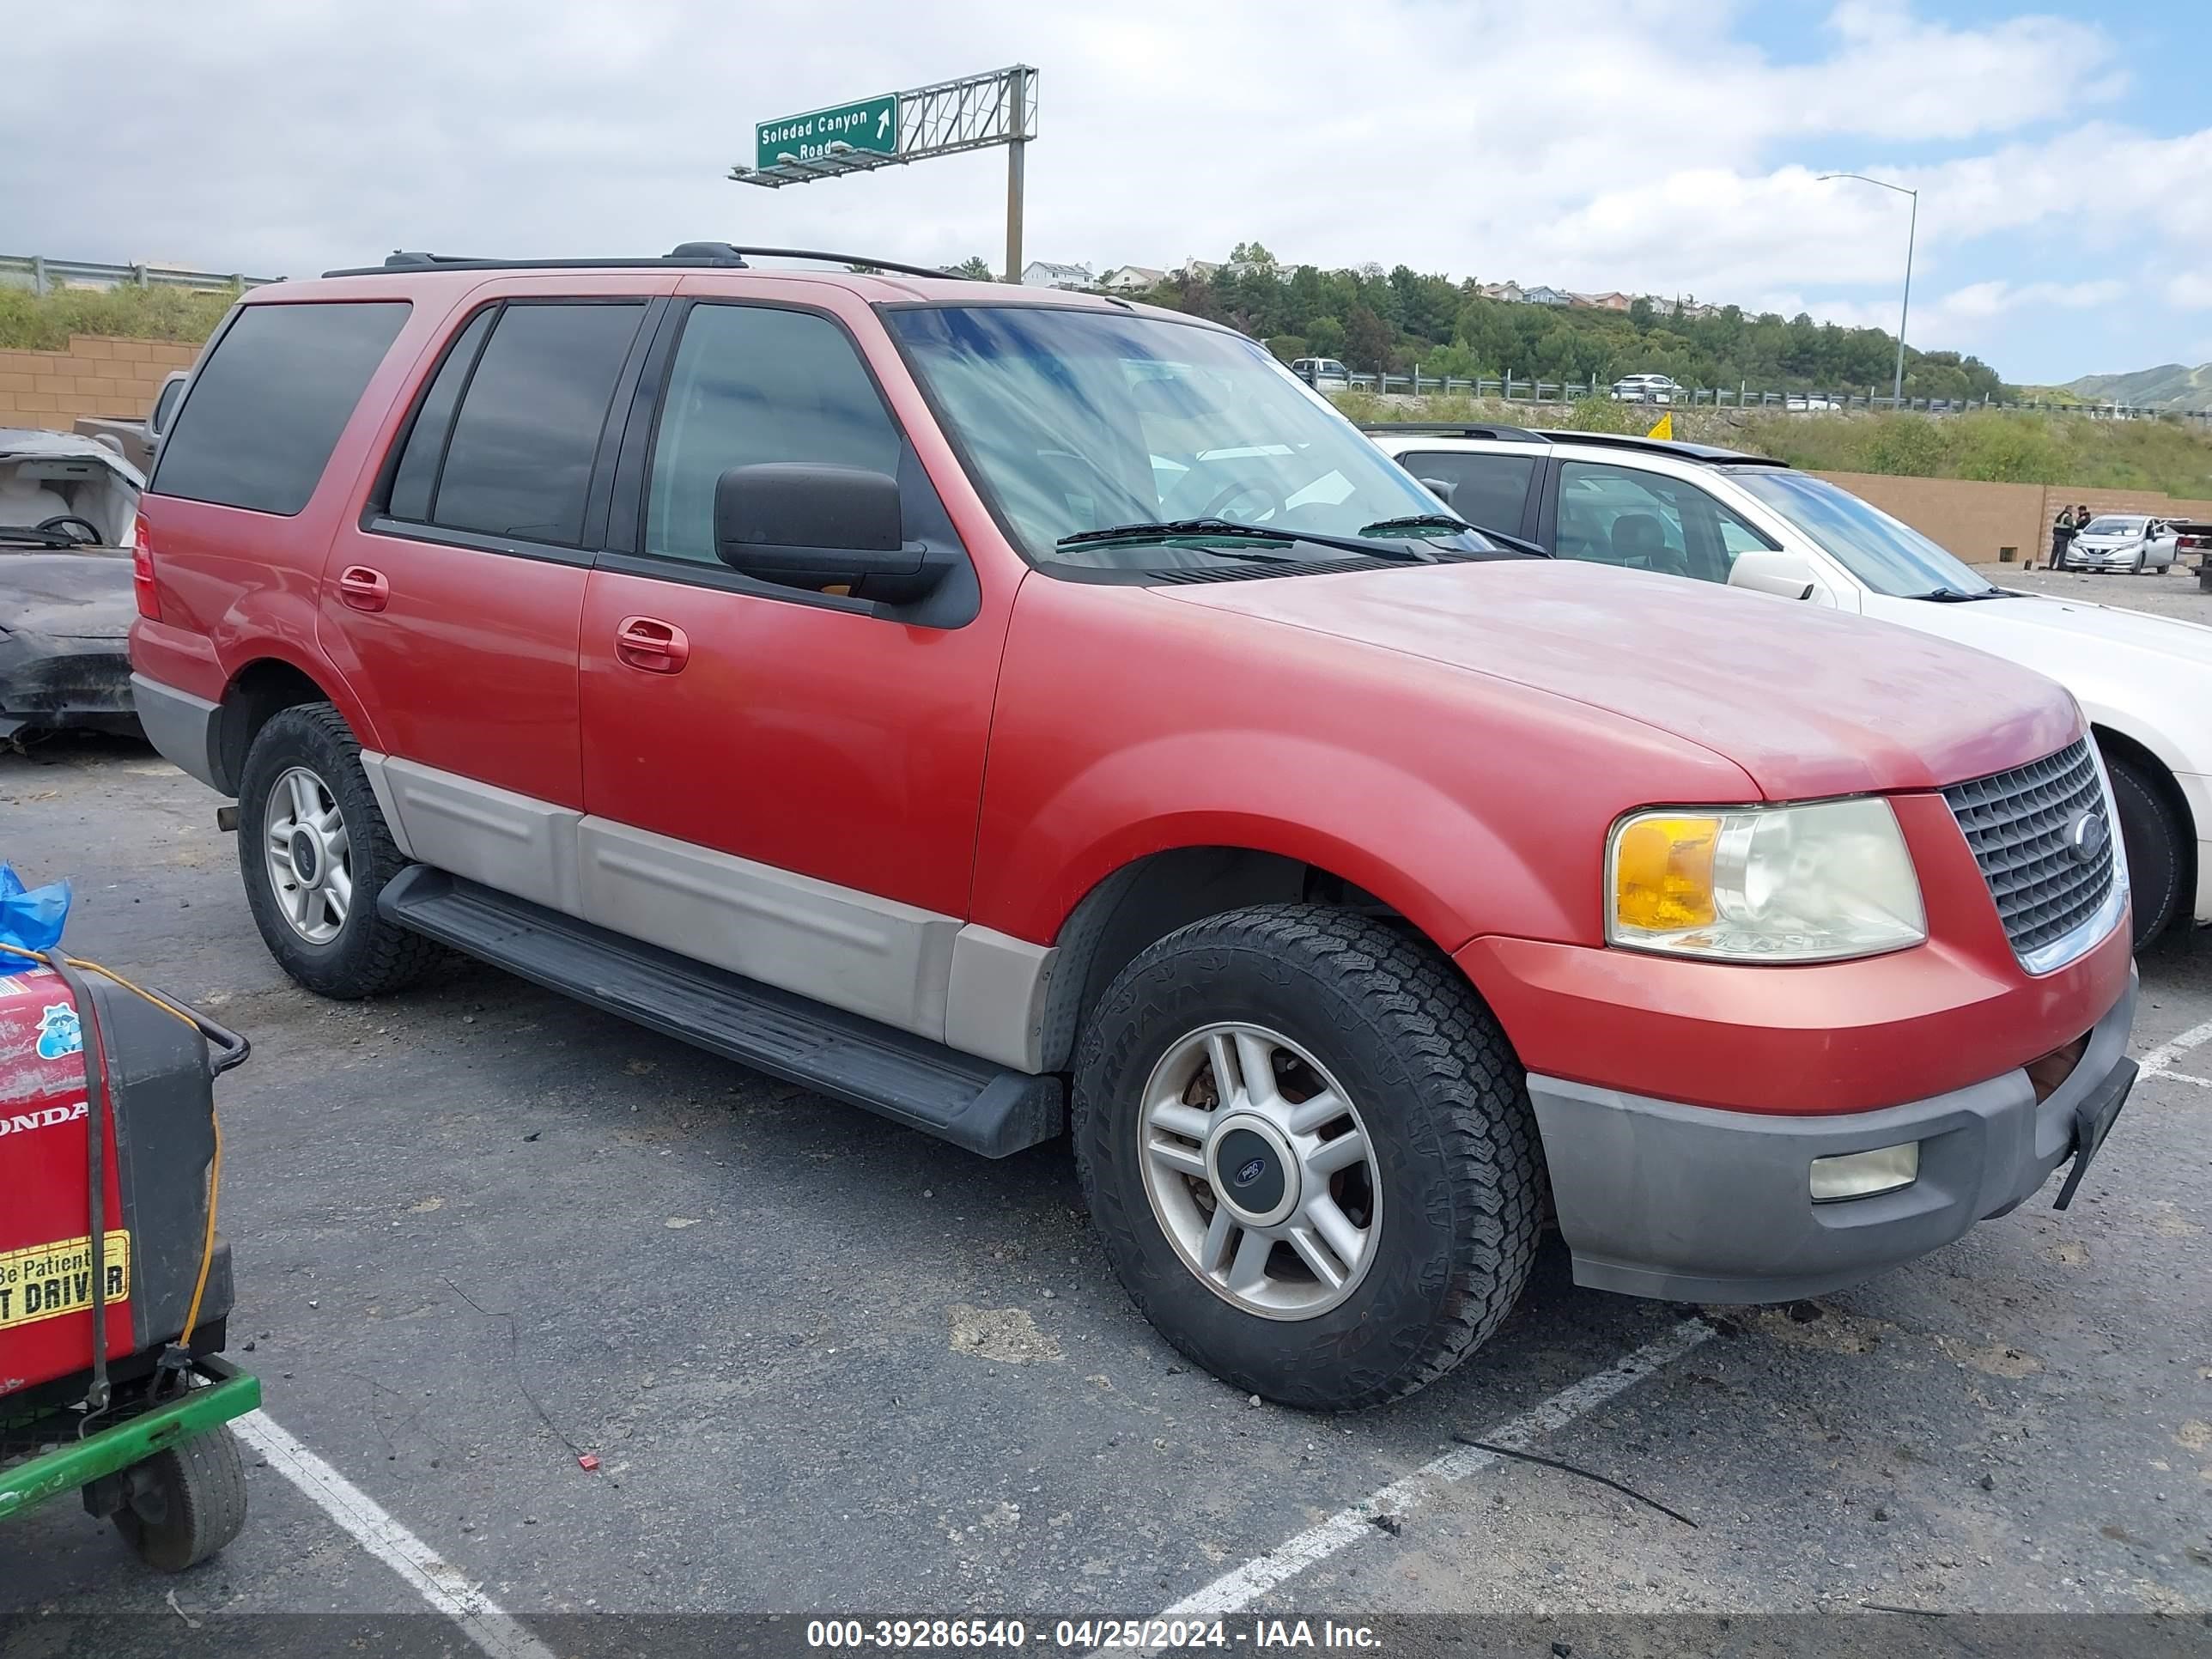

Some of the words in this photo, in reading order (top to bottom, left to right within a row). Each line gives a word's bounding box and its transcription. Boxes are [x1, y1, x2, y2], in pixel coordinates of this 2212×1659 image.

[763, 120, 812, 144] Soledad
[818, 111, 867, 133] Canyon
[799, 139, 831, 160] Road
[24, 1249, 91, 1280] Patient
[25, 1265, 123, 1315] DRIVR
